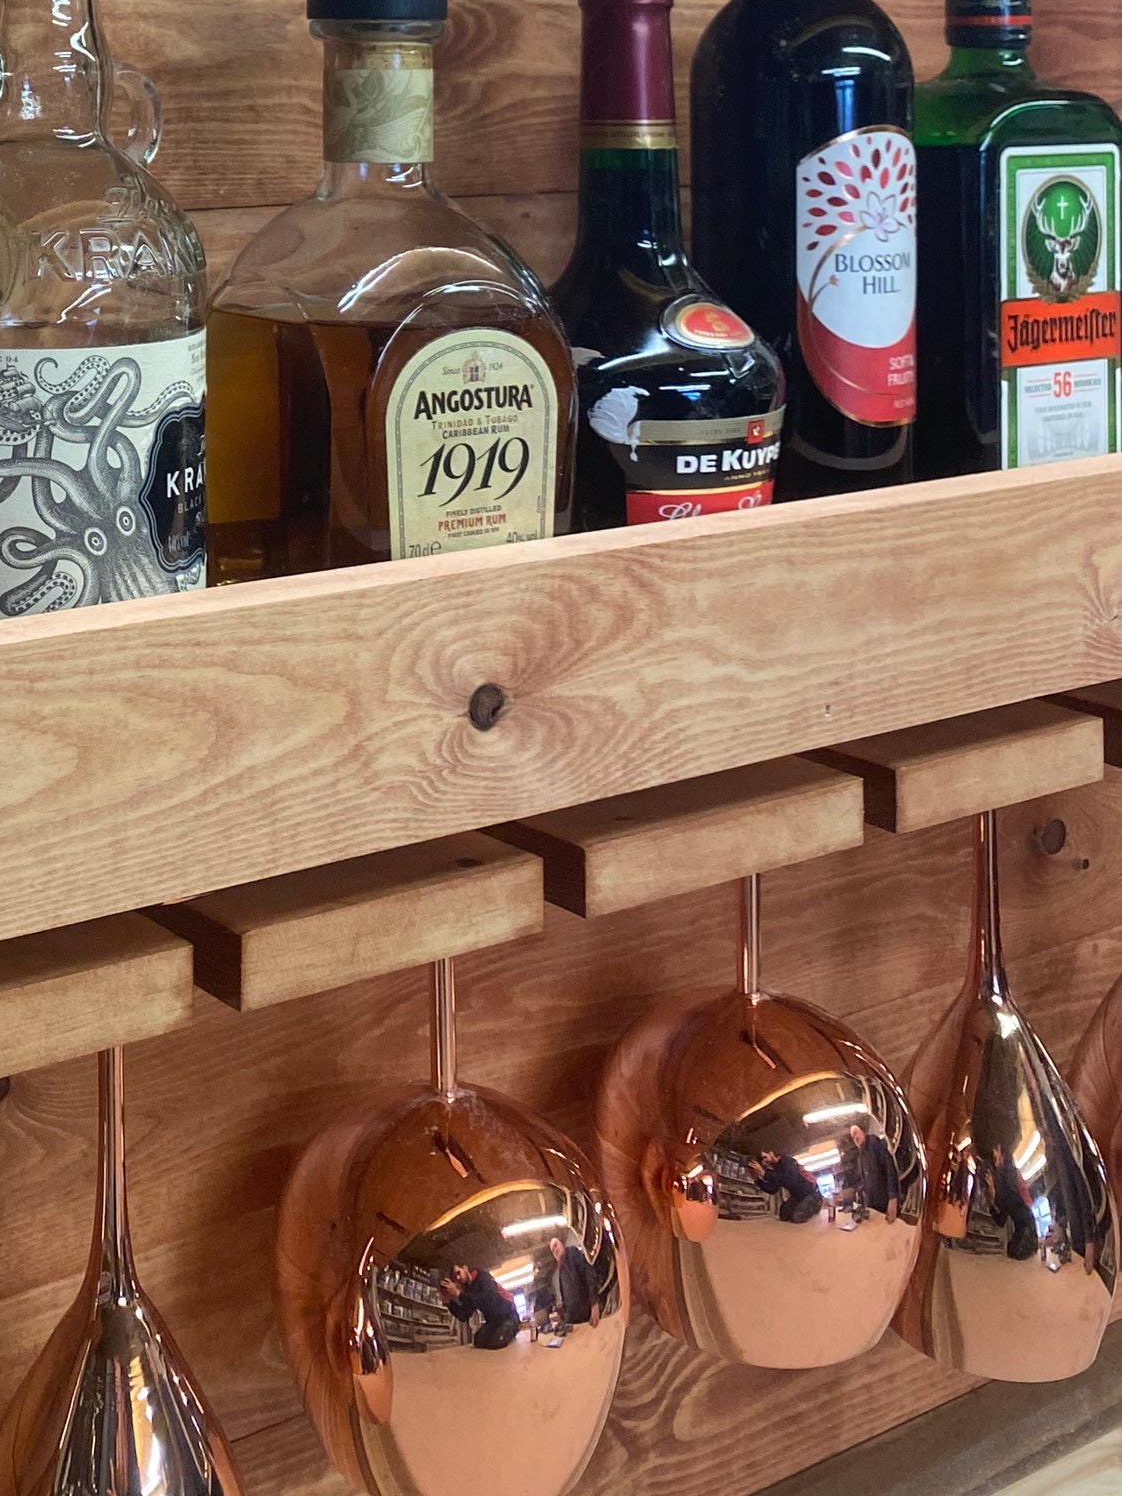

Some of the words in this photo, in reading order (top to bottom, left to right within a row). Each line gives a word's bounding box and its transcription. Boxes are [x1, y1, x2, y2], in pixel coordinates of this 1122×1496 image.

[862, 275, 901, 295] HILL
[1053, 370, 1072, 398] 56
[413, 384, 533, 421] ANGOSTURA
[431, 418, 474, 431] TRINIDAD
[485, 414, 518, 425] TOBAGO
[442, 426, 489, 440] CARIBBEAN
[491, 424, 510, 435] RUM
[417, 436, 530, 508] 1919
[676, 454, 718, 474] DE
[166, 462, 205, 499] KRA
[445, 509, 469, 518] FINELY
[470, 505, 502, 515] DISTILLED
[437, 516, 484, 532] PREMIUM
[485, 513, 507, 526] RUM
